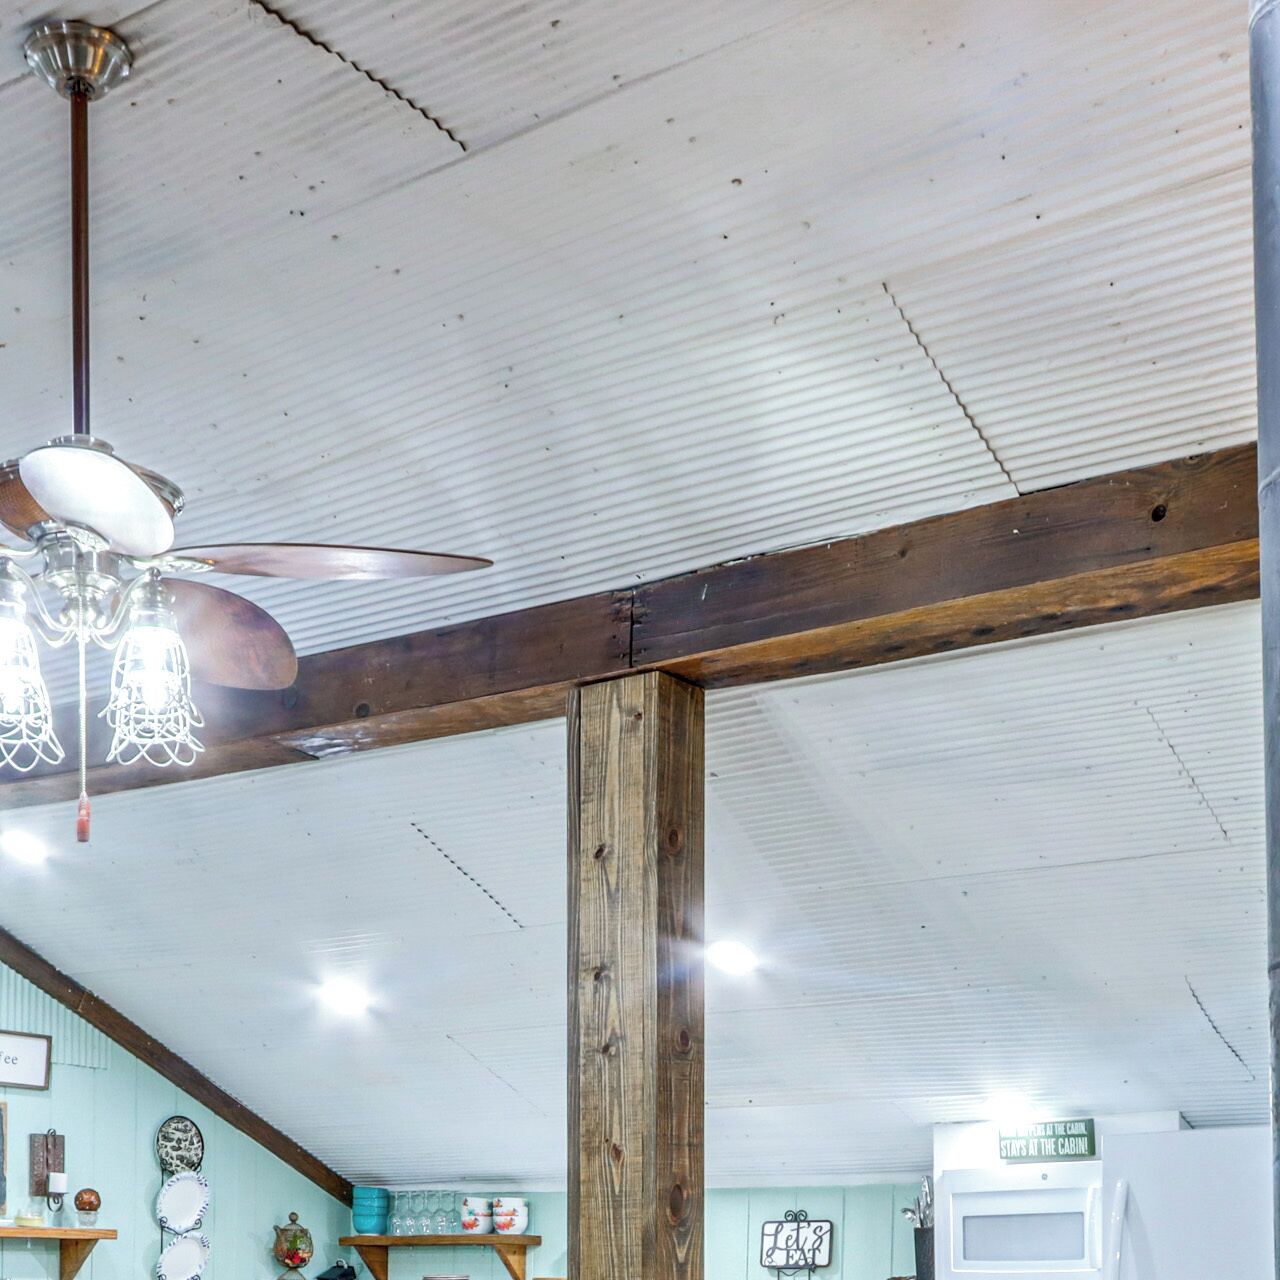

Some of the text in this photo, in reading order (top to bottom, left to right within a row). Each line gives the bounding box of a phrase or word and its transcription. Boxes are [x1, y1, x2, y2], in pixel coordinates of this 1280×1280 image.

[1055, 1123, 1066, 1135] THE
[1001, 1137, 1088, 1157] STAYS AT THE CABIN!
[764, 1222, 830, 1258] Let's
[785, 1248, 821, 1266] EAT
